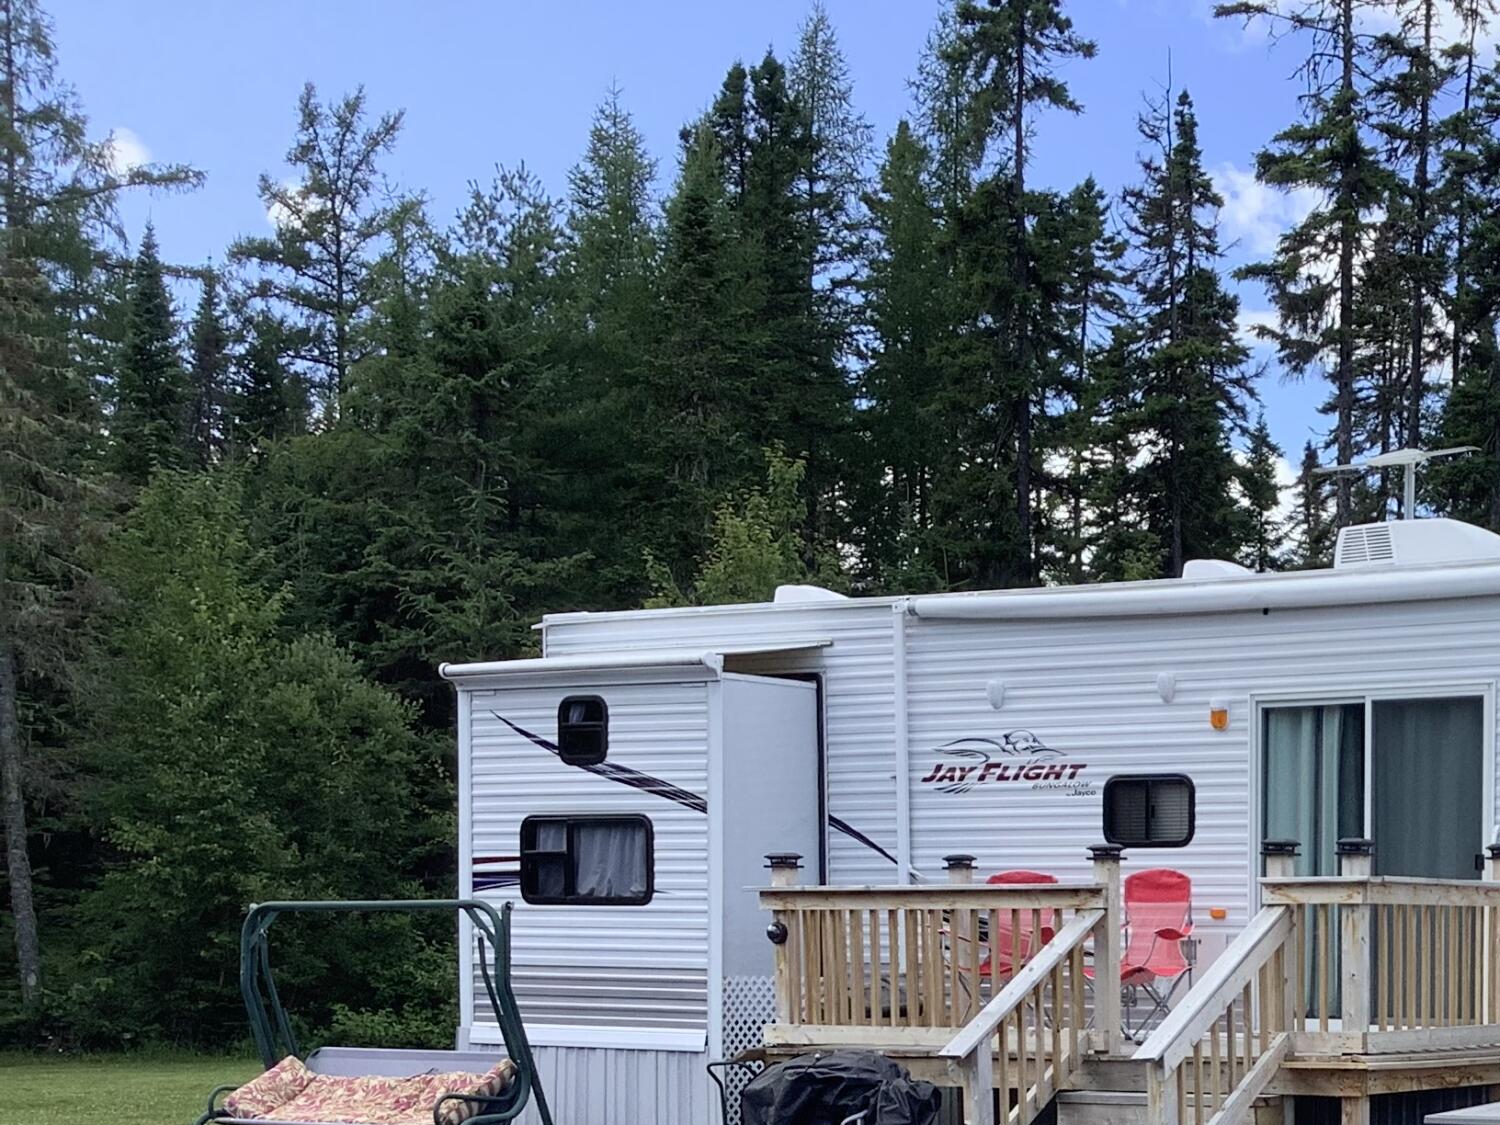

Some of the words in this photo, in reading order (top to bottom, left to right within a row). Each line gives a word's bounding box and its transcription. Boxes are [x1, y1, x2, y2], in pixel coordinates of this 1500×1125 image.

[920, 763, 977, 783] JAY
[977, 762, 1088, 783] FLIGHT
[1071, 789, 1097, 797] Jayco
